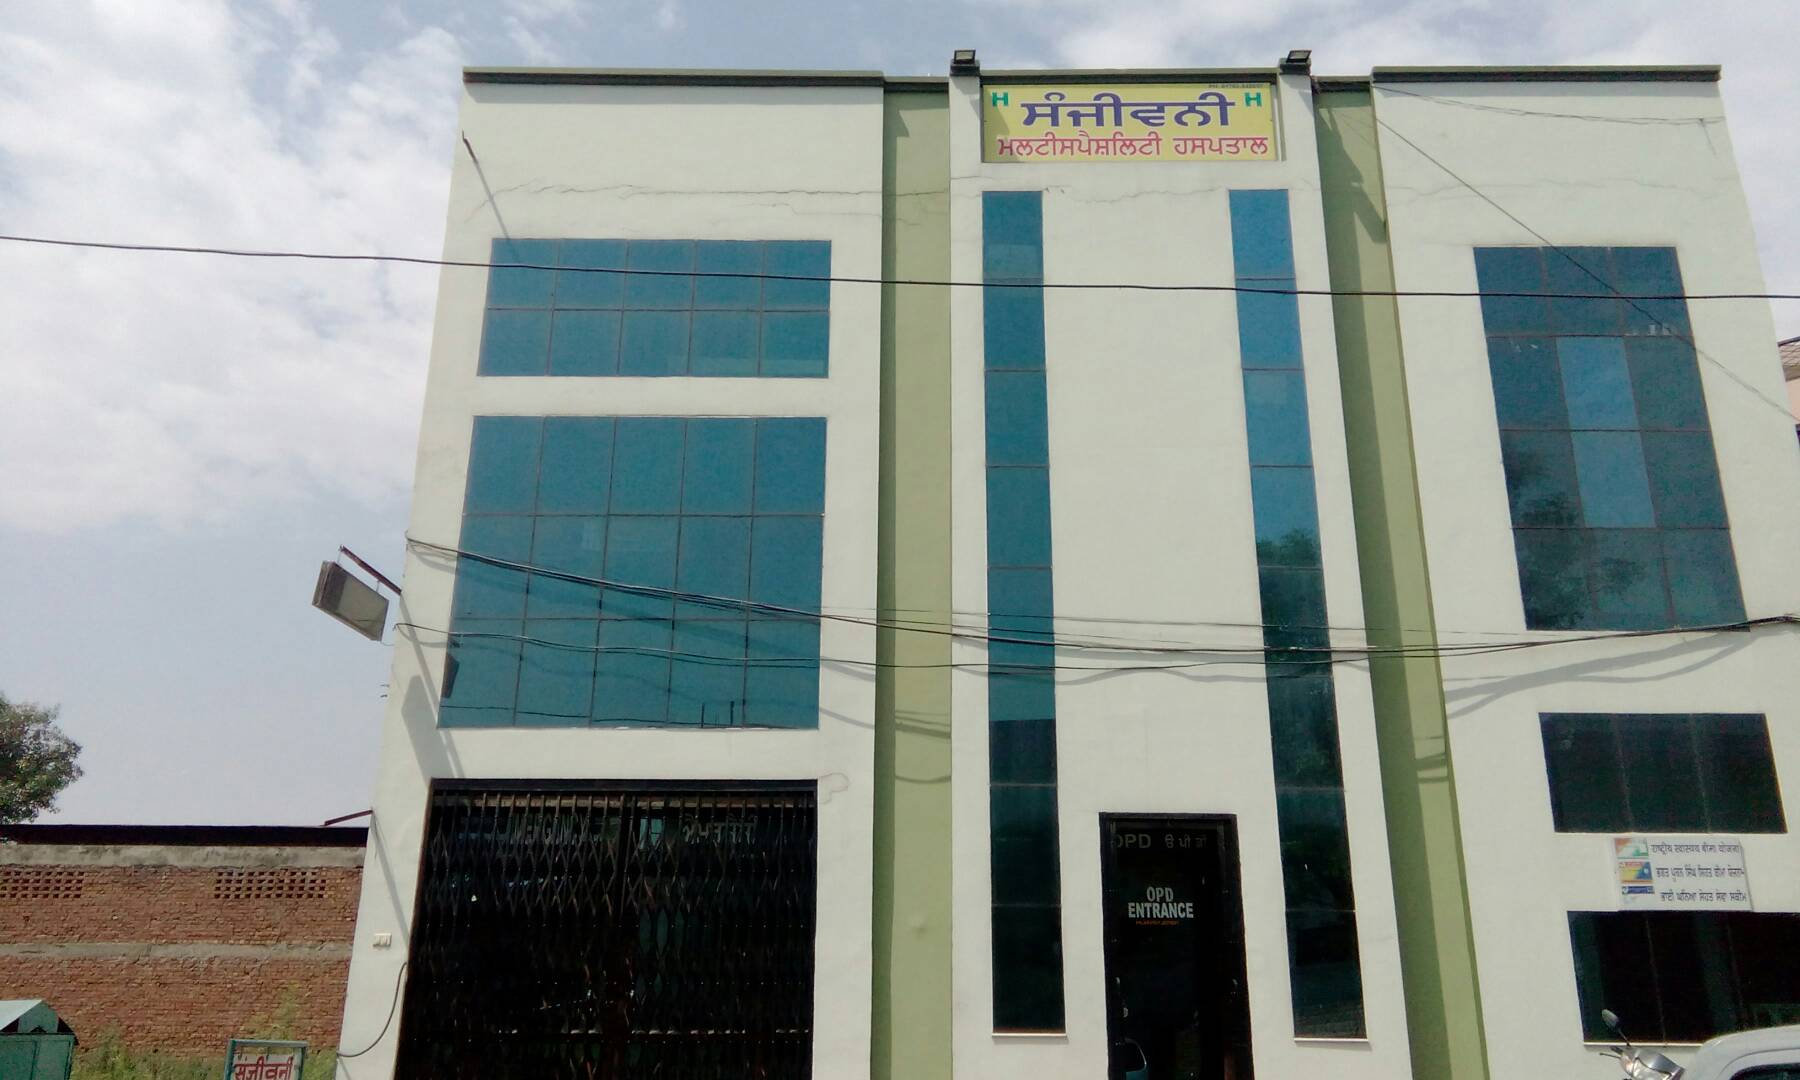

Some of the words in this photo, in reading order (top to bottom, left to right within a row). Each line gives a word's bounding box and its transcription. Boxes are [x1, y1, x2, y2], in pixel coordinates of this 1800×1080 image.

[1020, 91, 1235, 127] ਸੰਜੀਵਨੀ
[1172, 136, 1268, 155] ਹਸਪਤਾਲ
[1146, 886, 1174, 903] OPD
[1127, 902, 1194, 919] ENTRANCE
